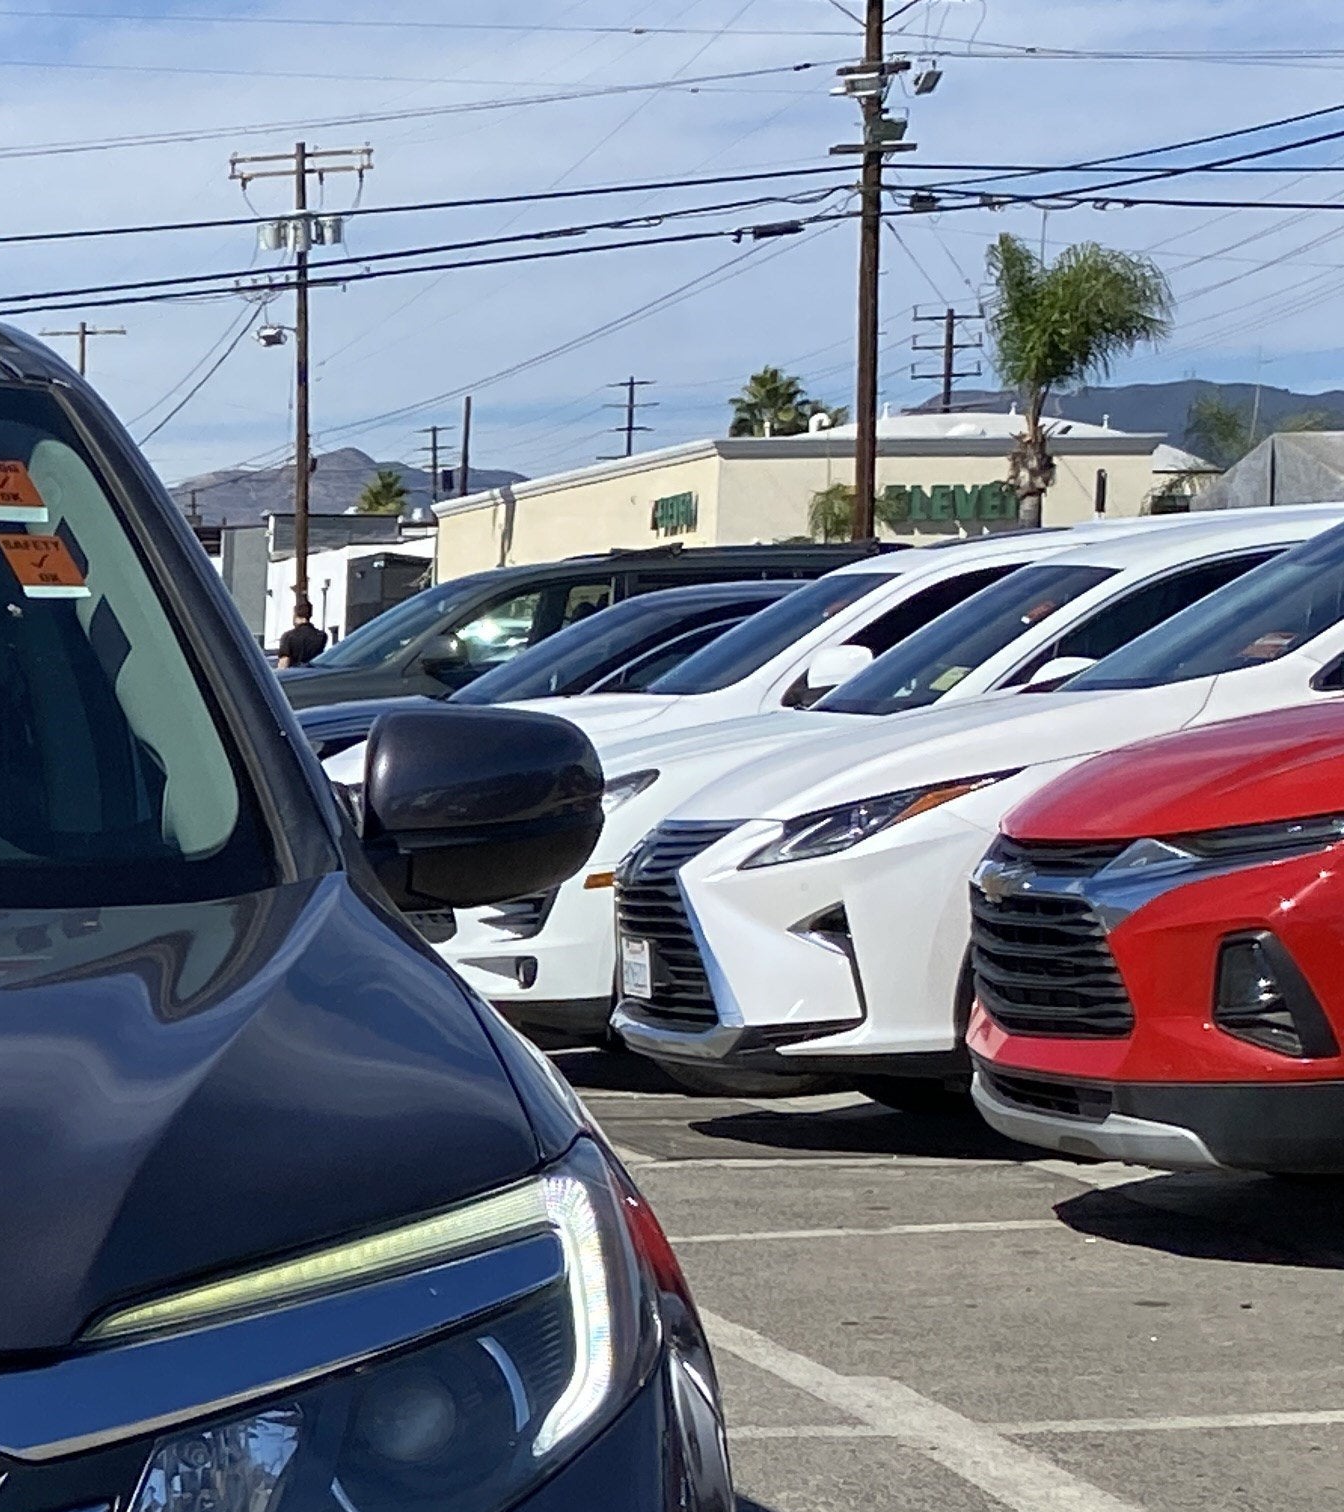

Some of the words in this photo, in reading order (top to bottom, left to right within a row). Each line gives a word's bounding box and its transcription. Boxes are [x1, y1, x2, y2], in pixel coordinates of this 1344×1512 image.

[0, 492, 23, 502] OK
[1, 539, 61, 550] SAFETY
[38, 572, 62, 582] OK
